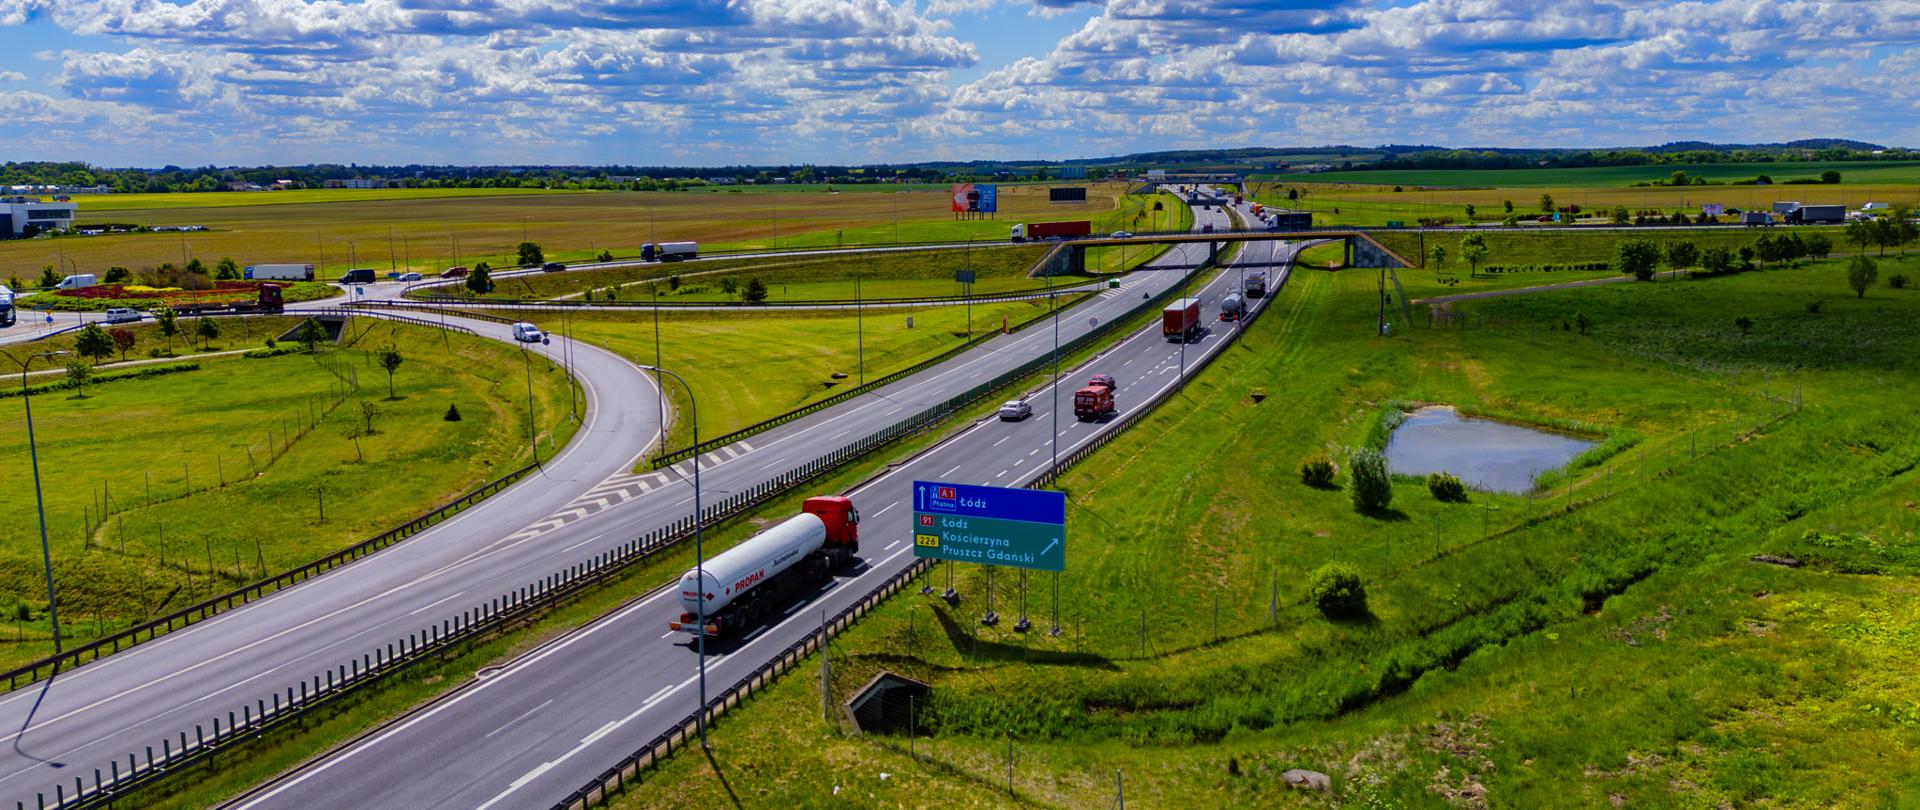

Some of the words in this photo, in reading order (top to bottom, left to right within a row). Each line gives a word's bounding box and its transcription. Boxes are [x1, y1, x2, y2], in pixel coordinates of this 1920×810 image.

[960, 496, 987, 509] Łódź
[922, 516, 932, 525] 91
[942, 518, 968, 529] Łódź
[920, 536, 936, 546] 226
[942, 531, 1010, 548] Kościerzyna
[942, 545, 982, 558] Pruszcz
[986, 549, 1034, 563] Gdański
[735, 568, 765, 592] PROPAN
